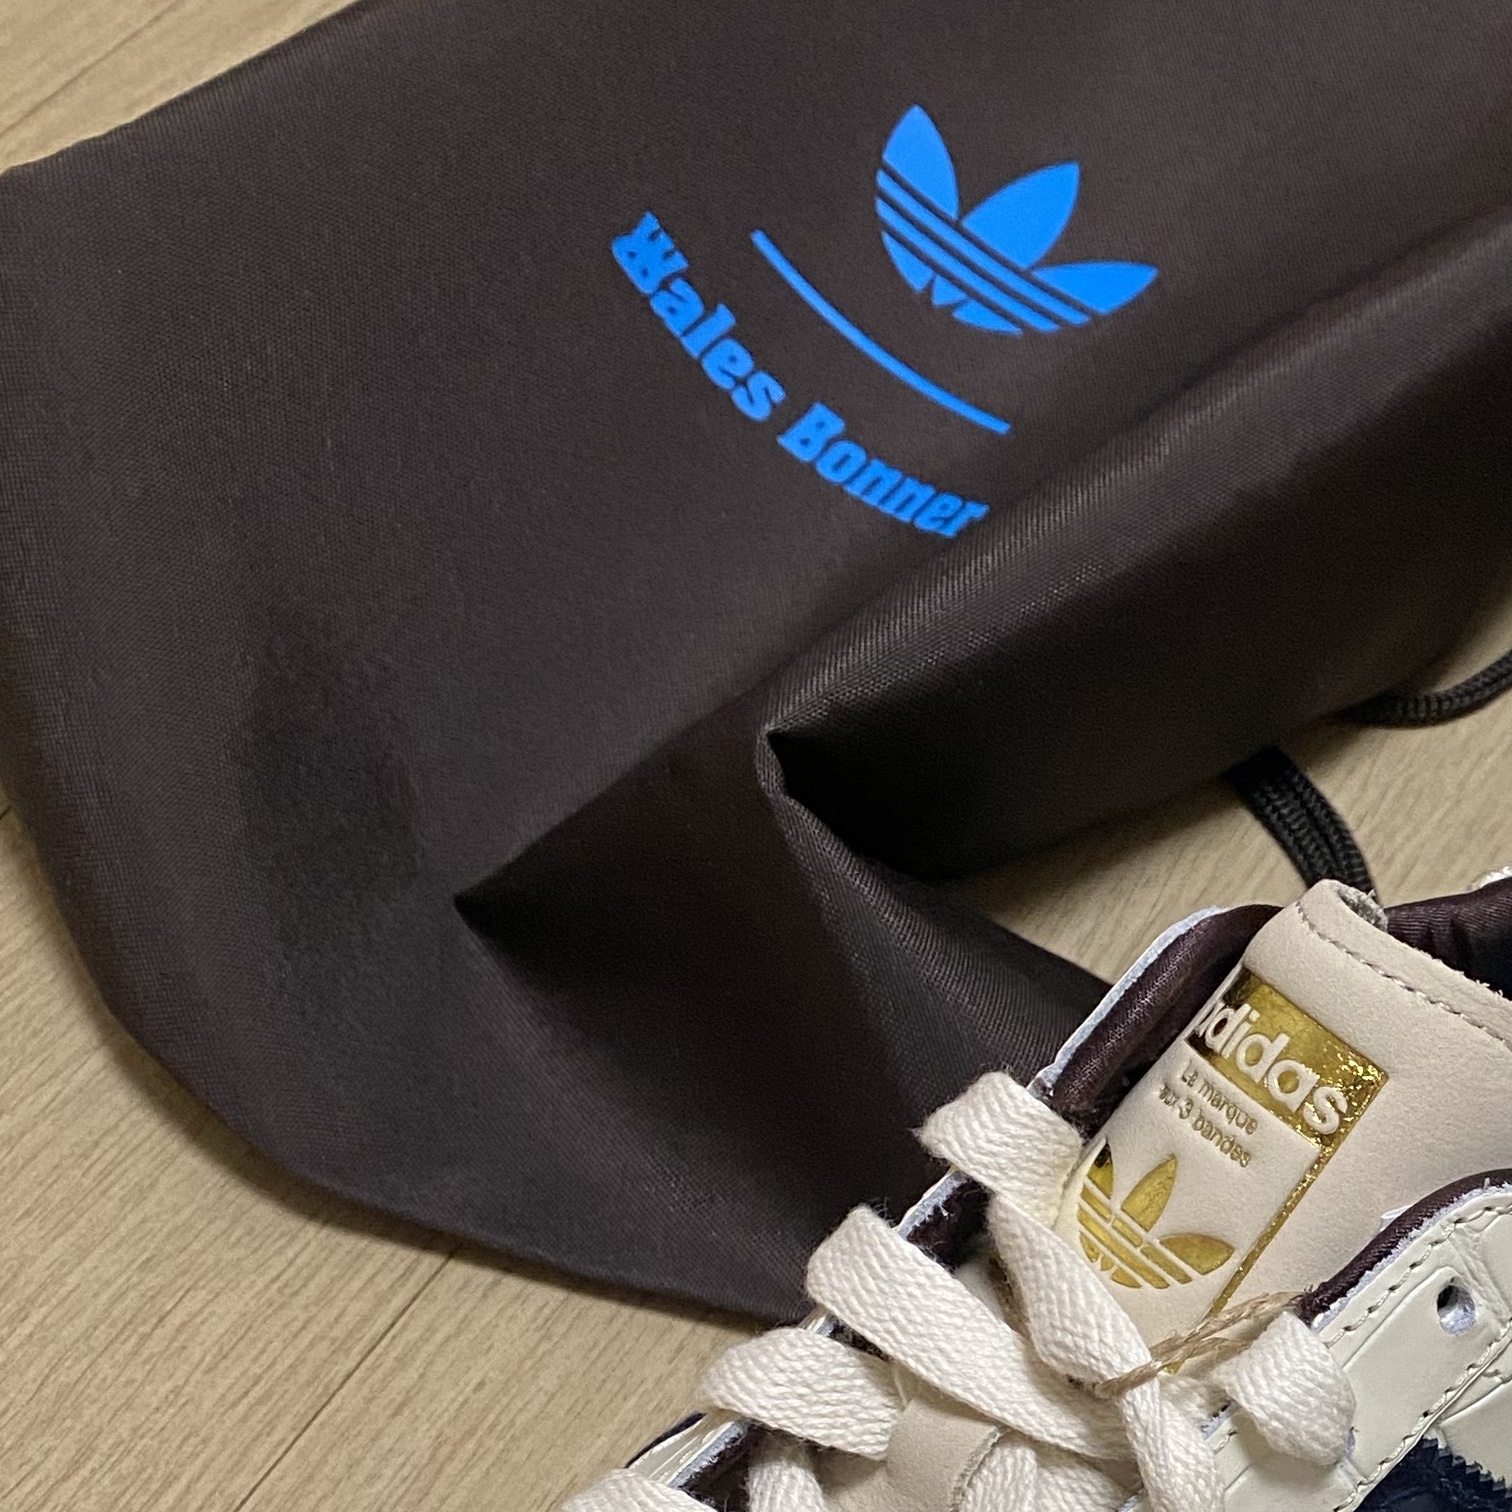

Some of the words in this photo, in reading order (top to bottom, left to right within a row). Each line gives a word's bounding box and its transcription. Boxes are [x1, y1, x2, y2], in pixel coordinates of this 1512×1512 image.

[611, 211, 786, 422] Wales
[776, 401, 990, 537] Bonner
[1198, 1079, 1258, 1135] marque
[1191, 1108, 1252, 1168] bandes
